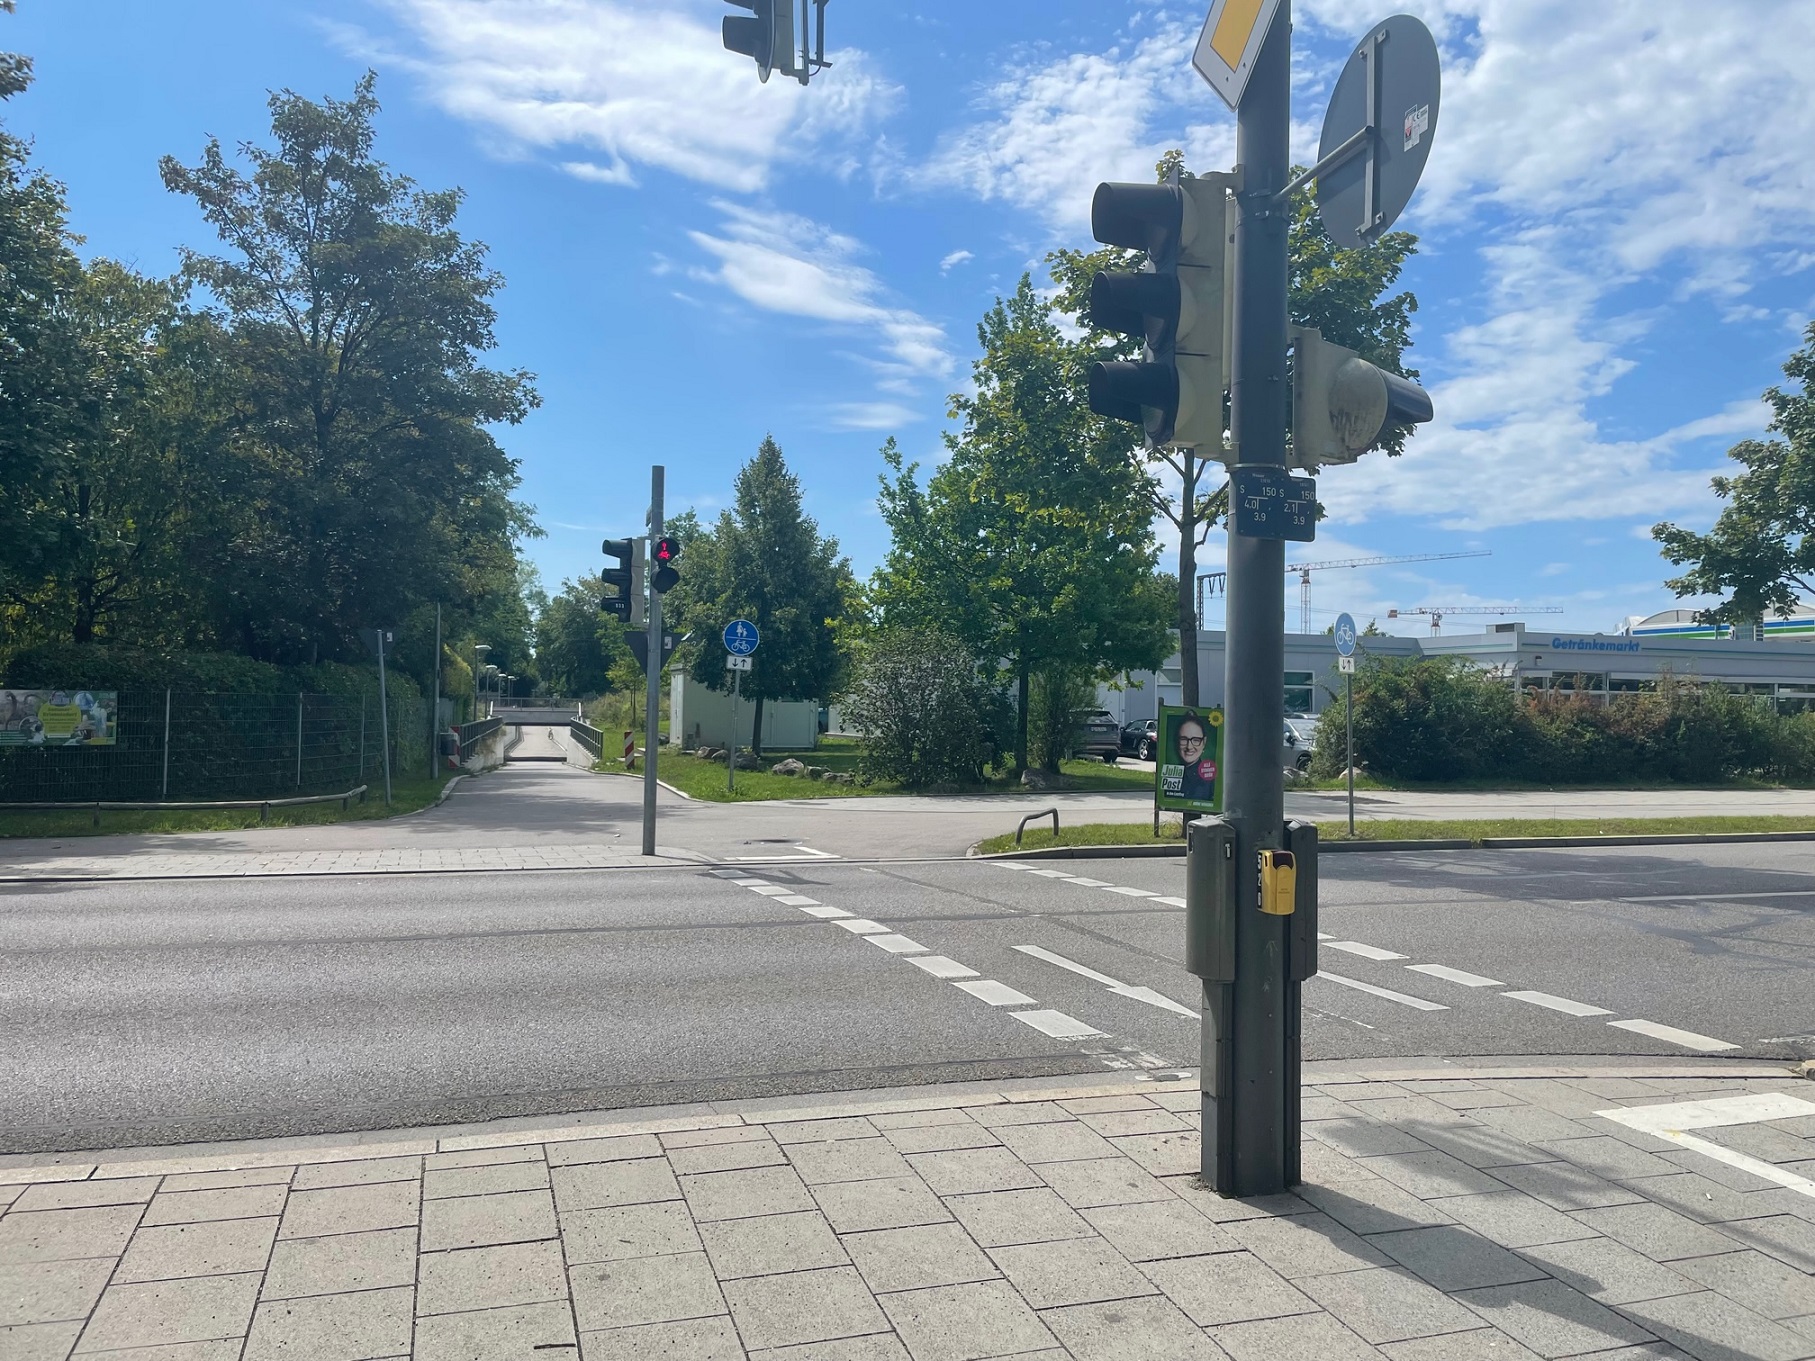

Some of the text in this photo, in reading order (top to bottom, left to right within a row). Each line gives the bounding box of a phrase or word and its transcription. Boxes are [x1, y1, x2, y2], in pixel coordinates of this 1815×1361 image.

[1240, 485, 1277, 497] S 150
[1279, 489, 1315, 500] S 150
[1244, 500, 1257, 509] 4.0
[1284, 503, 1295, 513] 2.1
[1253, 512, 1266, 521] 3.9
[1293, 516, 1305, 525] 3.9
[1552, 637, 1640, 652] Getränkemarkt
[1163, 765, 1183, 777] Julia
[1162, 778, 1181, 790] Post
